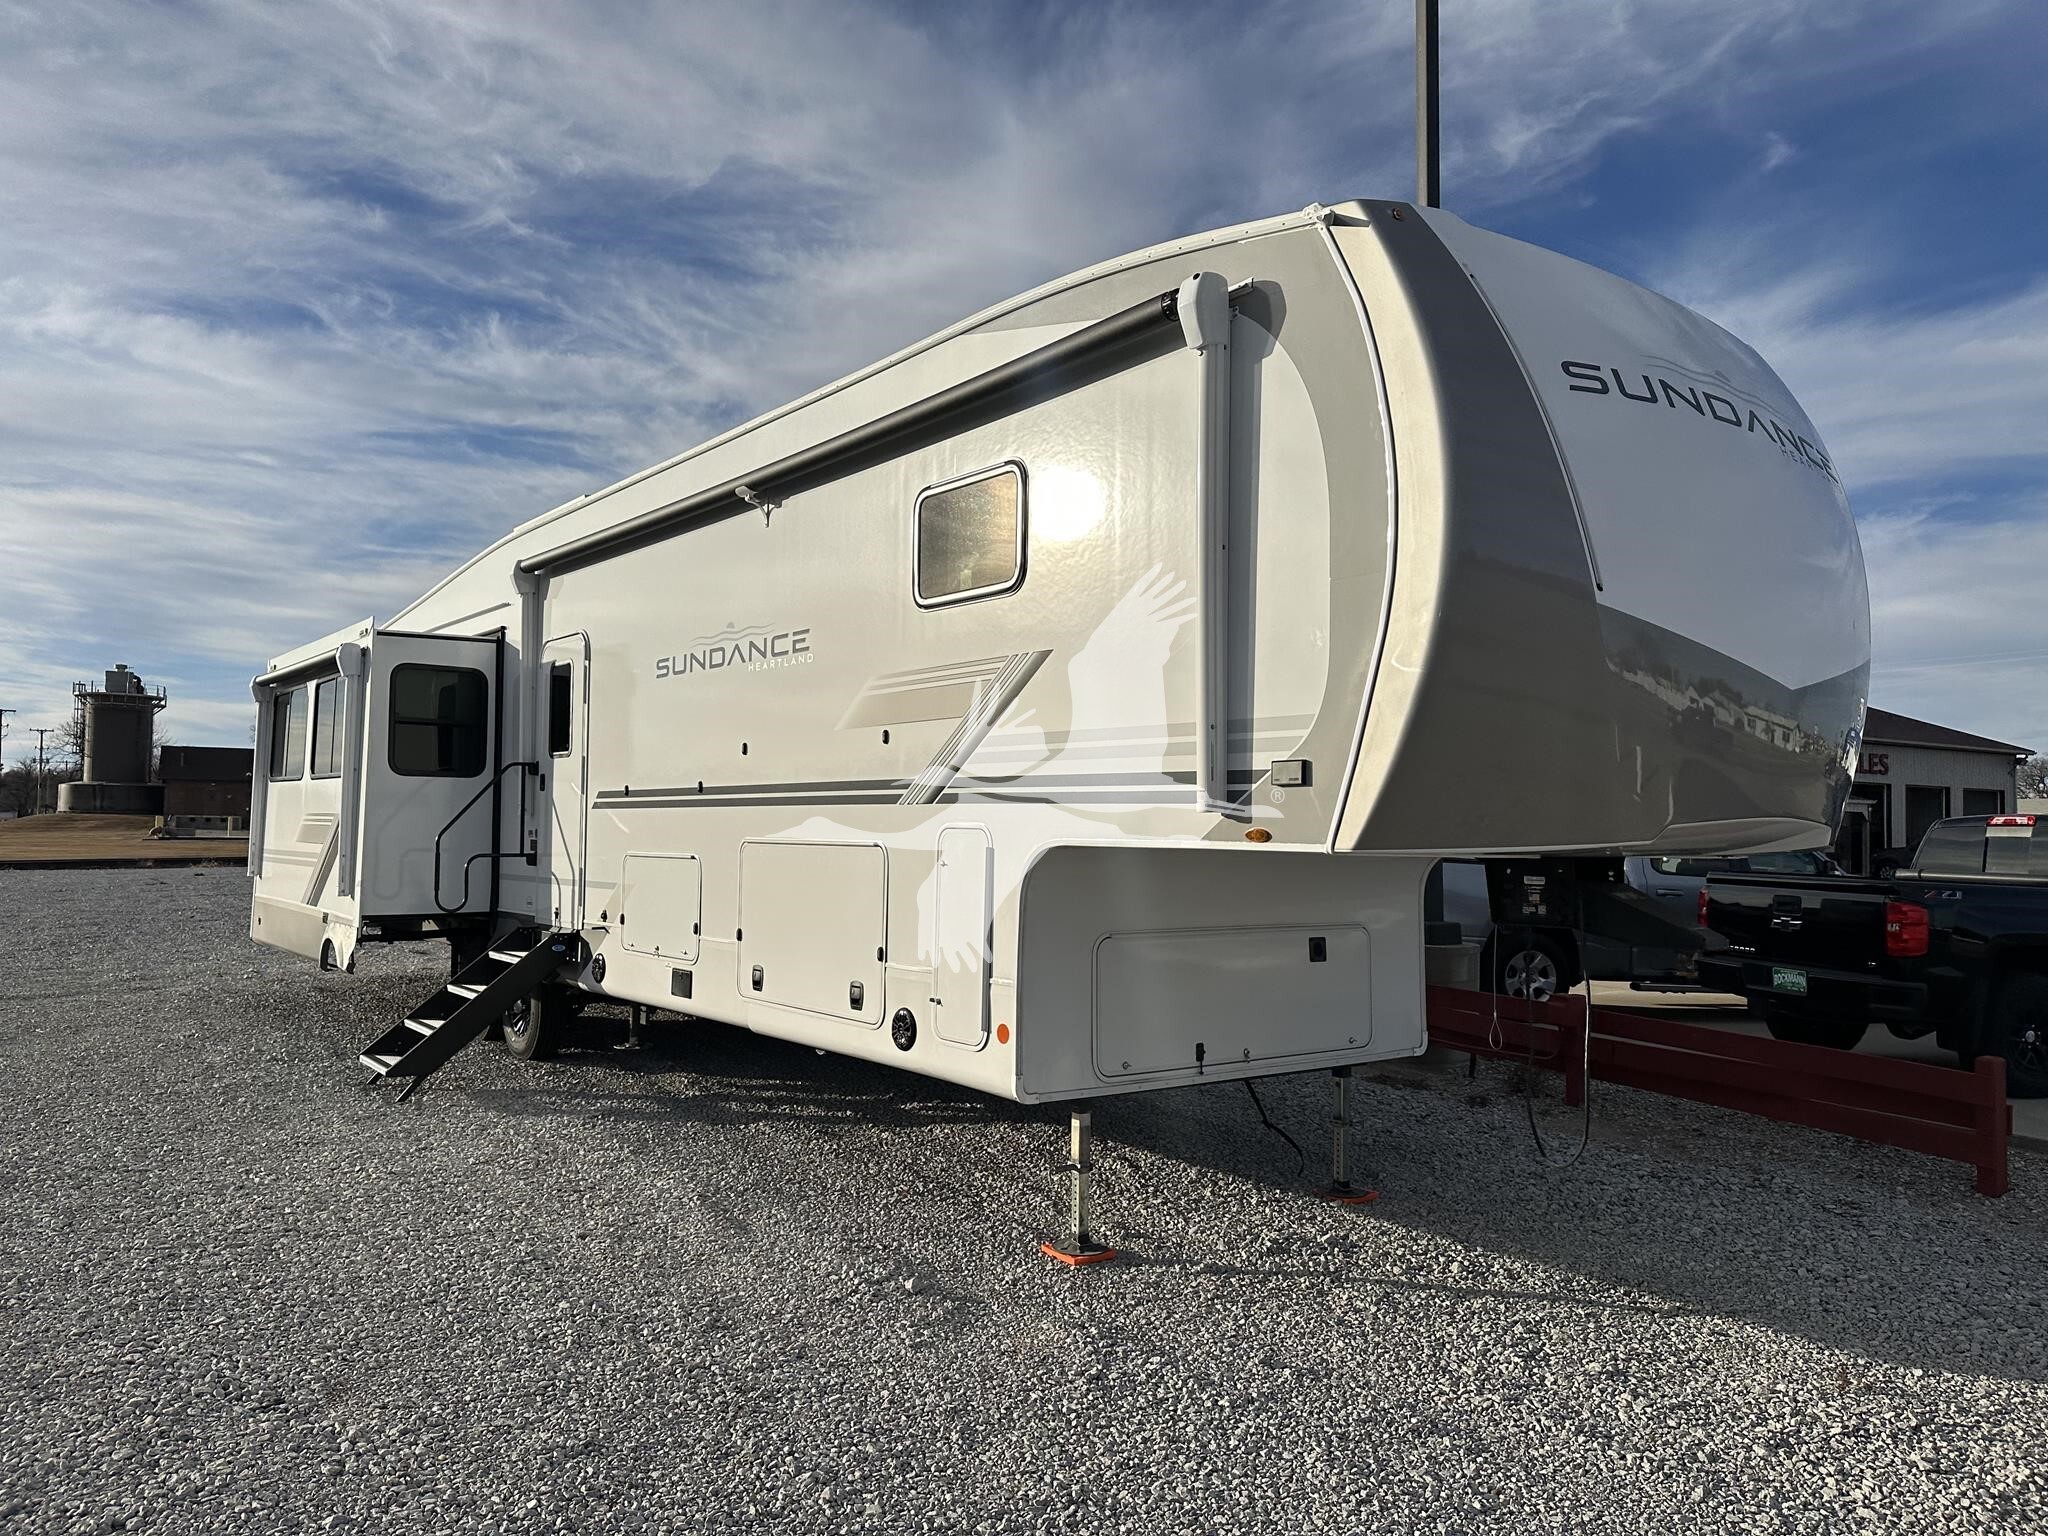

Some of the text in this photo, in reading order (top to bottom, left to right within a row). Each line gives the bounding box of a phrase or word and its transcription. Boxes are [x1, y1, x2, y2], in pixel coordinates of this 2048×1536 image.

[1560, 359, 1839, 485] SUNDANCE
[655, 628, 811, 679] SUNDANCE
[747, 653, 815, 673] HEARTLAND
[1856, 753, 1889, 776] LES
